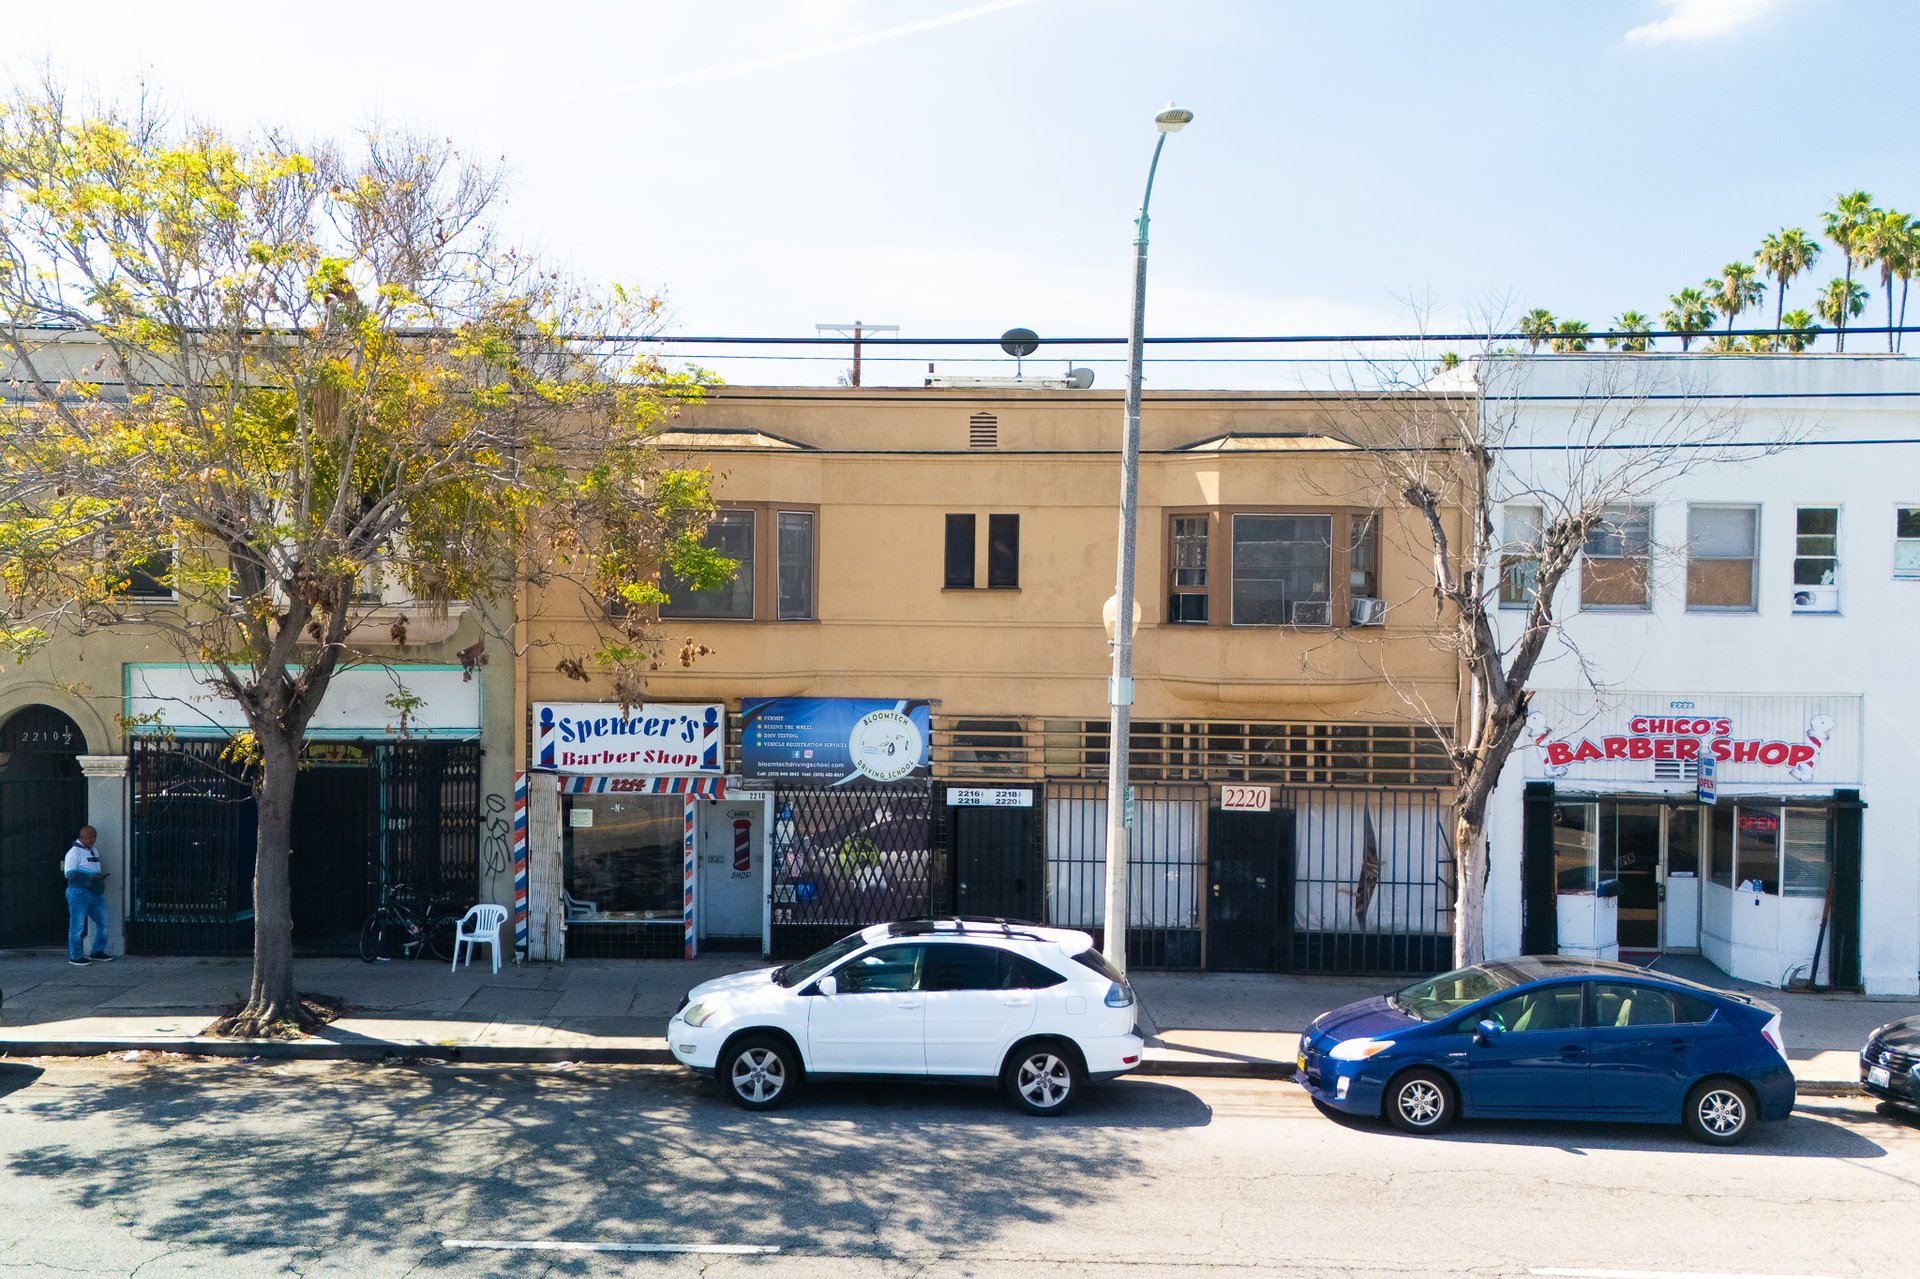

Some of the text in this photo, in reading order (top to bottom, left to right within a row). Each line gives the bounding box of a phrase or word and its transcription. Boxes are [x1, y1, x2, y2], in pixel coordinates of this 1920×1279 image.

[1671, 701, 1694, 709] 2222
[863, 712, 909, 726] BLOOMTECH
[1630, 717, 1731, 735] CHICO'S
[22, 731, 59, 741] 2210
[558, 715, 699, 744] Spencer's
[561, 749, 698, 767] Barber Shop
[1547, 737, 1815, 767] BARBER SHOP
[757, 761, 845, 769] bloomtechdrivingschool.com
[857, 759, 914, 779] DRIVING SCHOOL
[610, 778, 647, 792] 2214
[1224, 789, 1267, 808] 2220
[1740, 817, 1777, 830] OPEN
[730, 871, 752, 880] SHOP
